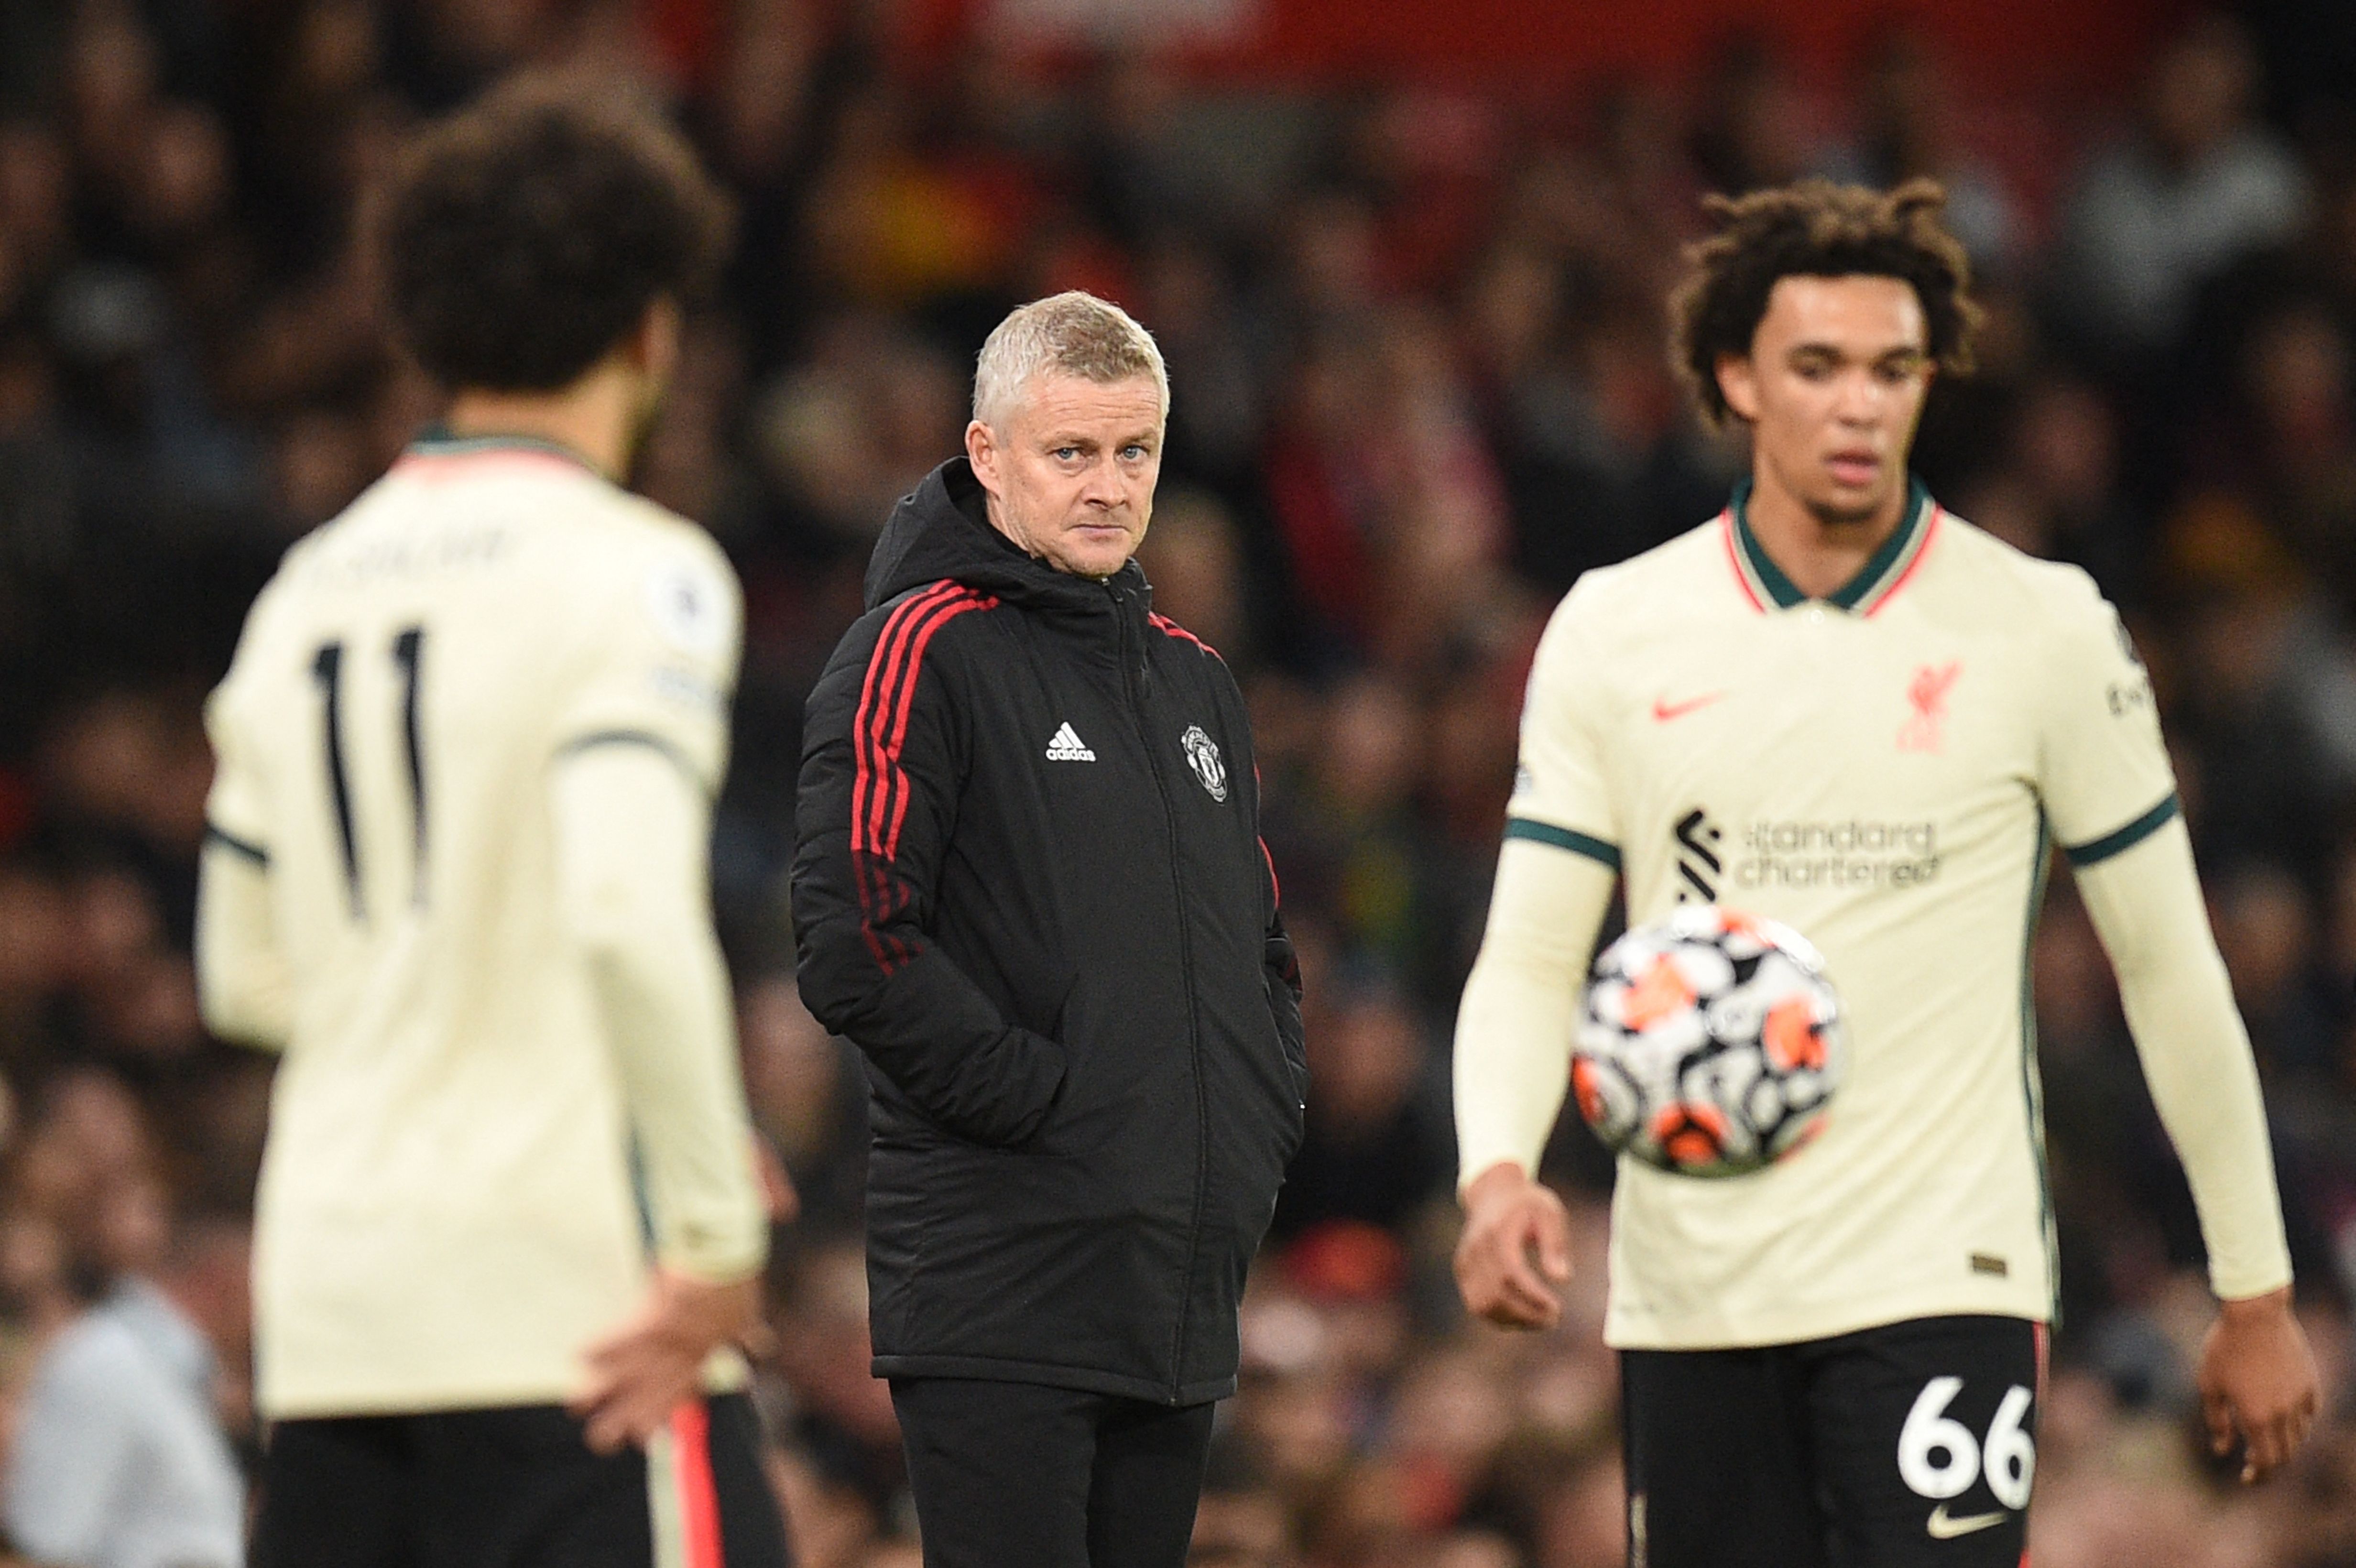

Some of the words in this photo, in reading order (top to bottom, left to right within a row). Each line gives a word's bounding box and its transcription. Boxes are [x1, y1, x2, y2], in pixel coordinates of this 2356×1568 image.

[1046, 748, 1096, 762] adidas
[310, 624, 430, 920] 11
[1741, 821, 1934, 852] standard
[1734, 858, 1940, 888] chartered
[1897, 1375, 2036, 1510] 66
